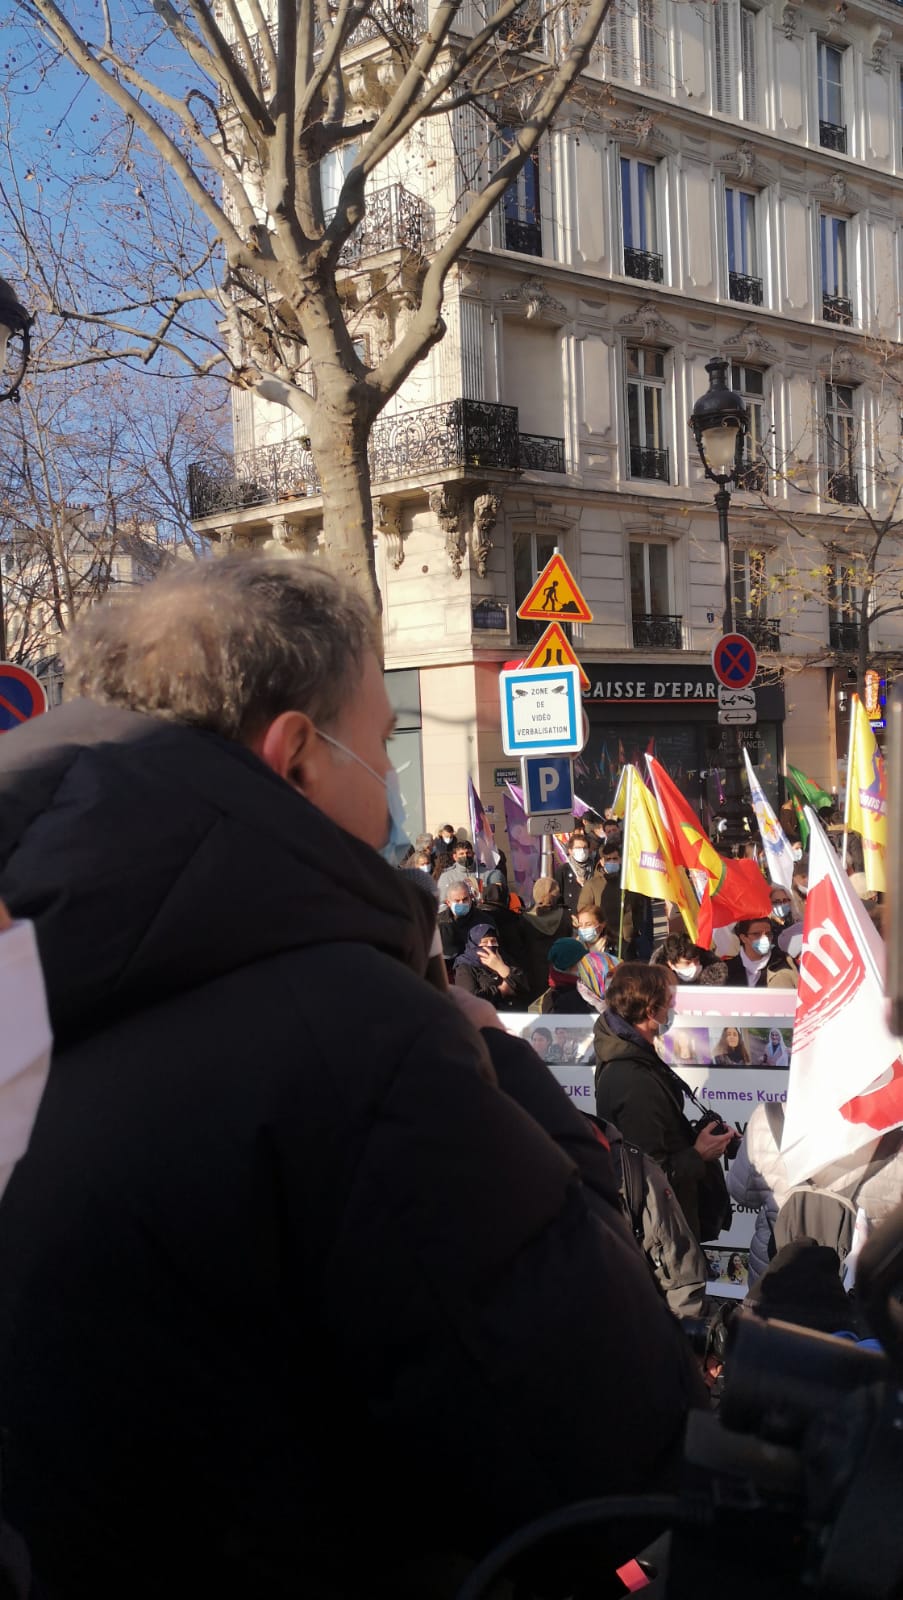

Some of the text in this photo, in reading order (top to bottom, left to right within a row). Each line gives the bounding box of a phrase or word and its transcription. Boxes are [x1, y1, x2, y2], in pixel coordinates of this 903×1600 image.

[531, 687, 549, 696] ZONE
[653, 682, 721, 698] D'EPAR
[531, 713, 551, 722] VIDÉO
[517, 726, 568, 736] VERBALISATION
[538, 766, 560, 803] P
[702, 1087, 753, 1101] femmes
